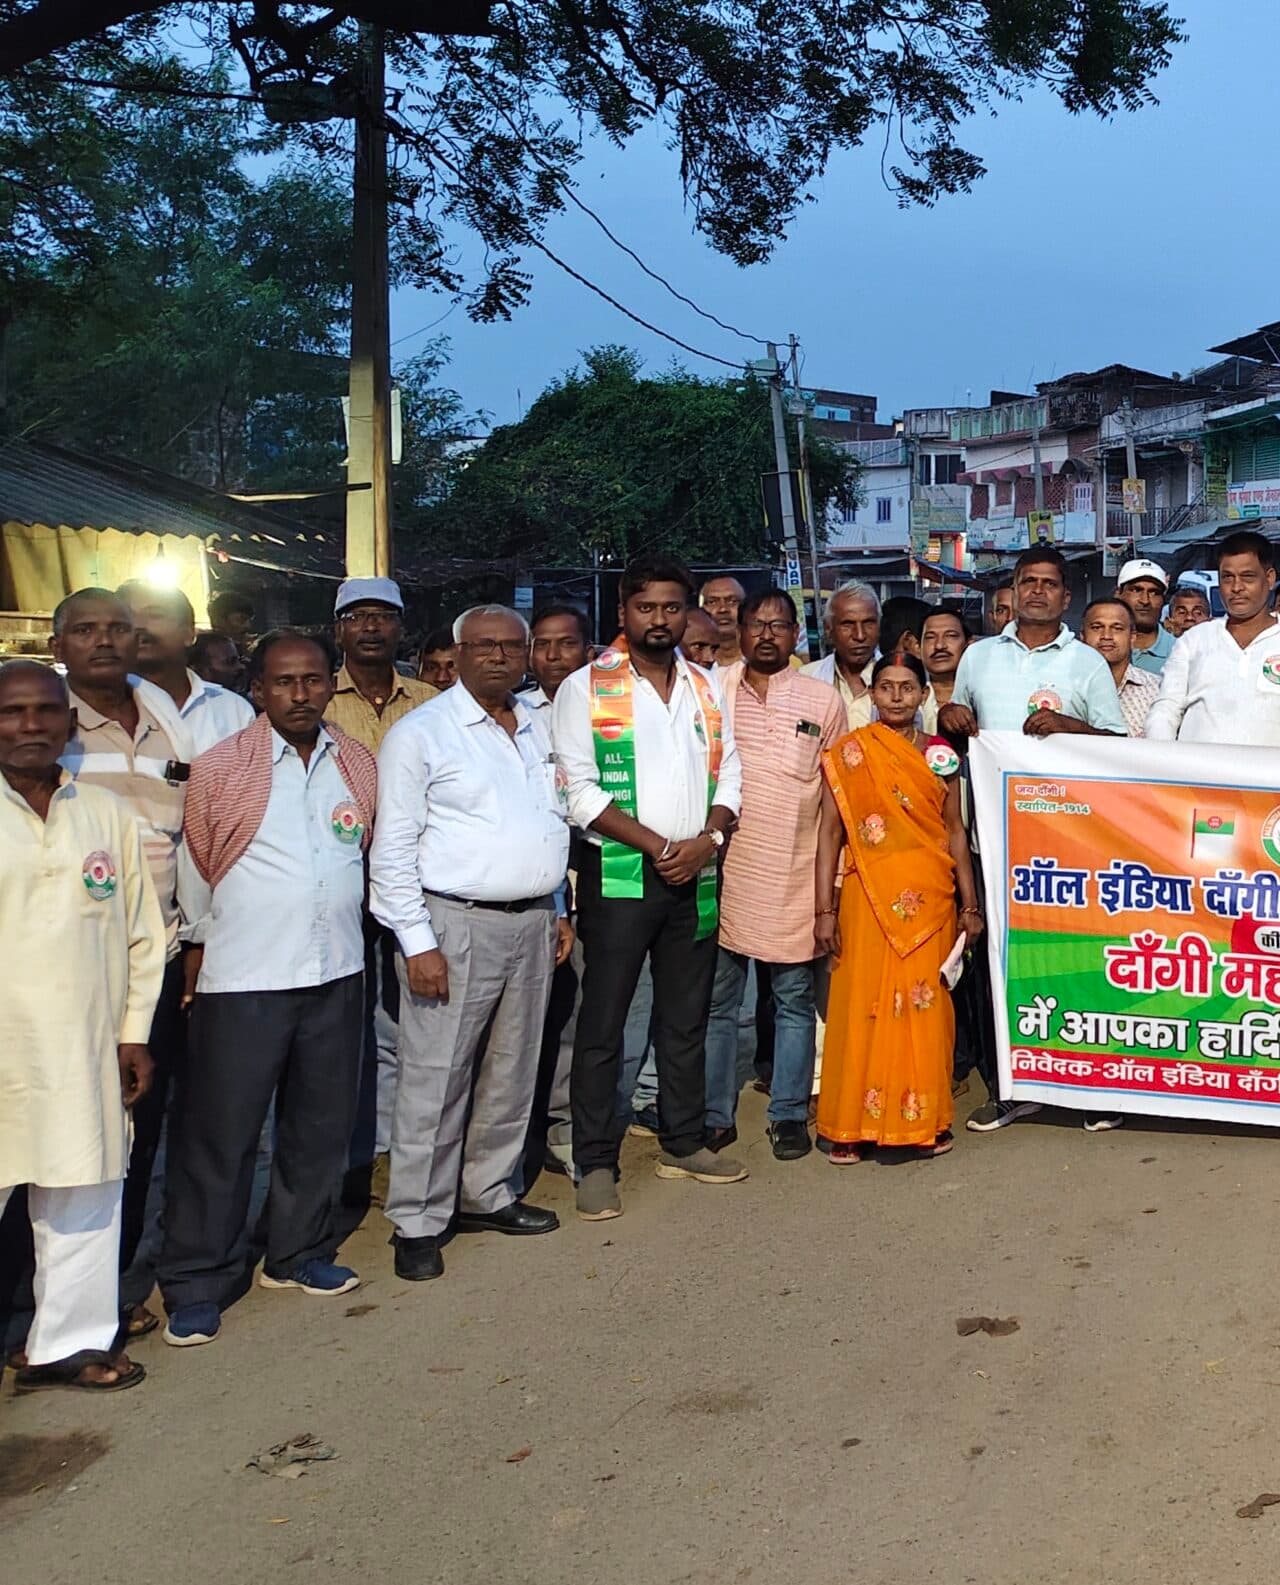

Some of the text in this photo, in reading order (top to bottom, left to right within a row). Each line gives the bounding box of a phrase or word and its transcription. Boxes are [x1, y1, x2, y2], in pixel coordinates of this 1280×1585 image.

[605, 752, 624, 764] ALL
[603, 770, 630, 783] INDIA
[1017, 785, 1034, 795] जय
[1014, 859, 1087, 906] ऑल
[1098, 863, 1192, 912] इंडिया
[1261, 931, 1280, 949] की
[1017, 996, 1057, 1040] में
[1060, 1010, 1190, 1051] आपका
[1161, 1062, 1230, 1089] इंडिया
